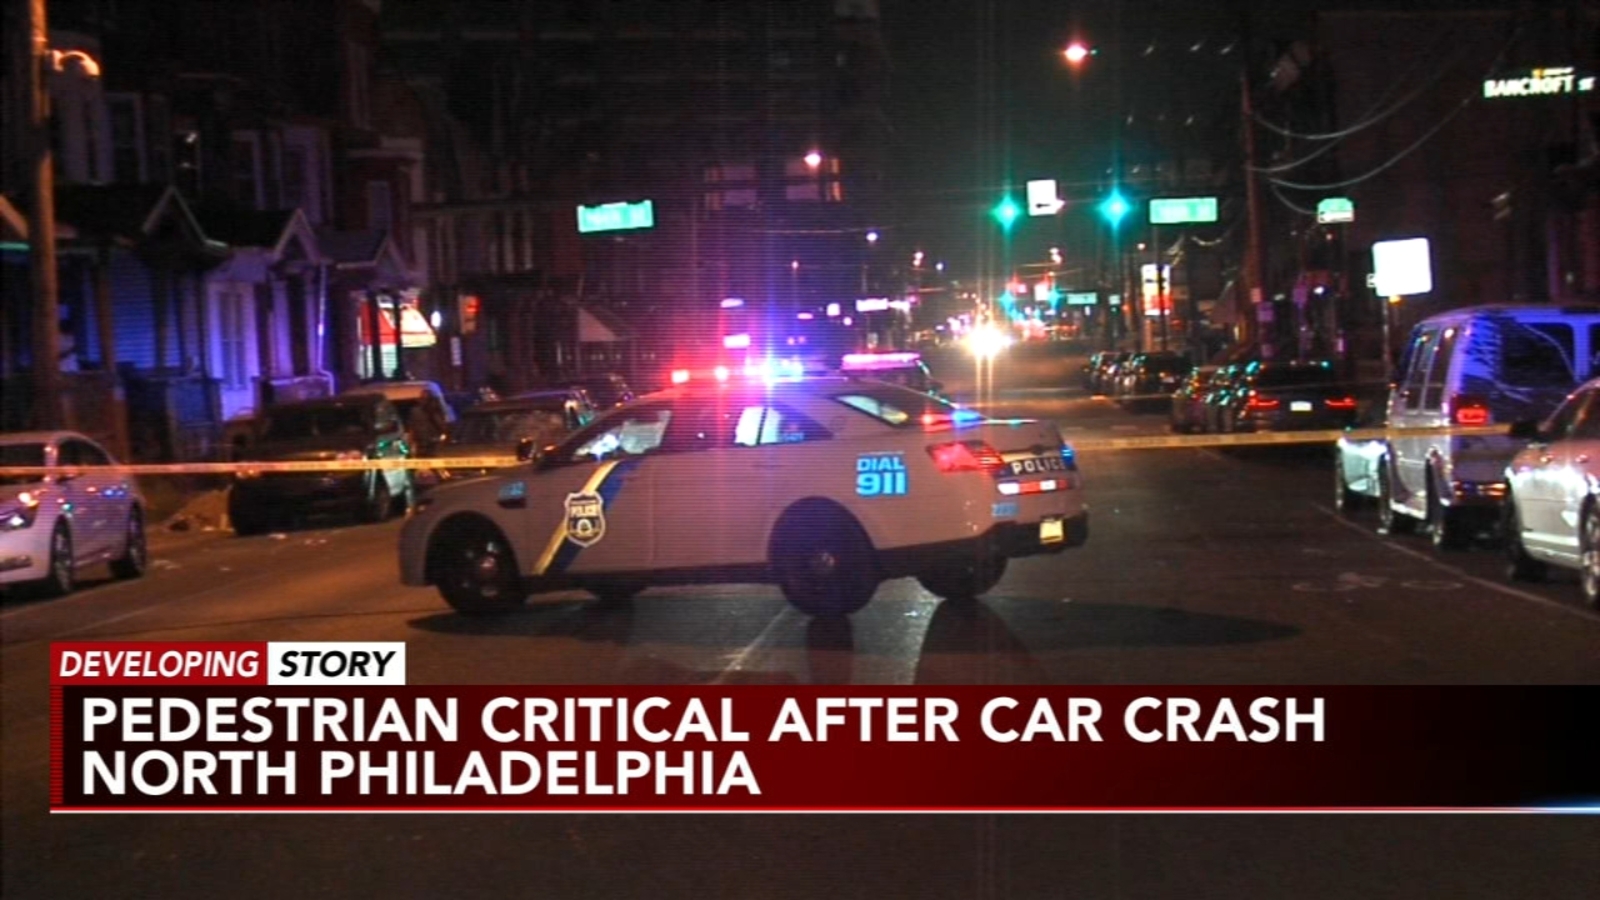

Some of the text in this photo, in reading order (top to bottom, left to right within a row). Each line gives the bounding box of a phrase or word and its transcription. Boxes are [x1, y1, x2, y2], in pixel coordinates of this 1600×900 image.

[1484, 76, 1575, 98] BANCROFT
[857, 456, 906, 472] DIAL
[855, 472, 906, 496] 911
